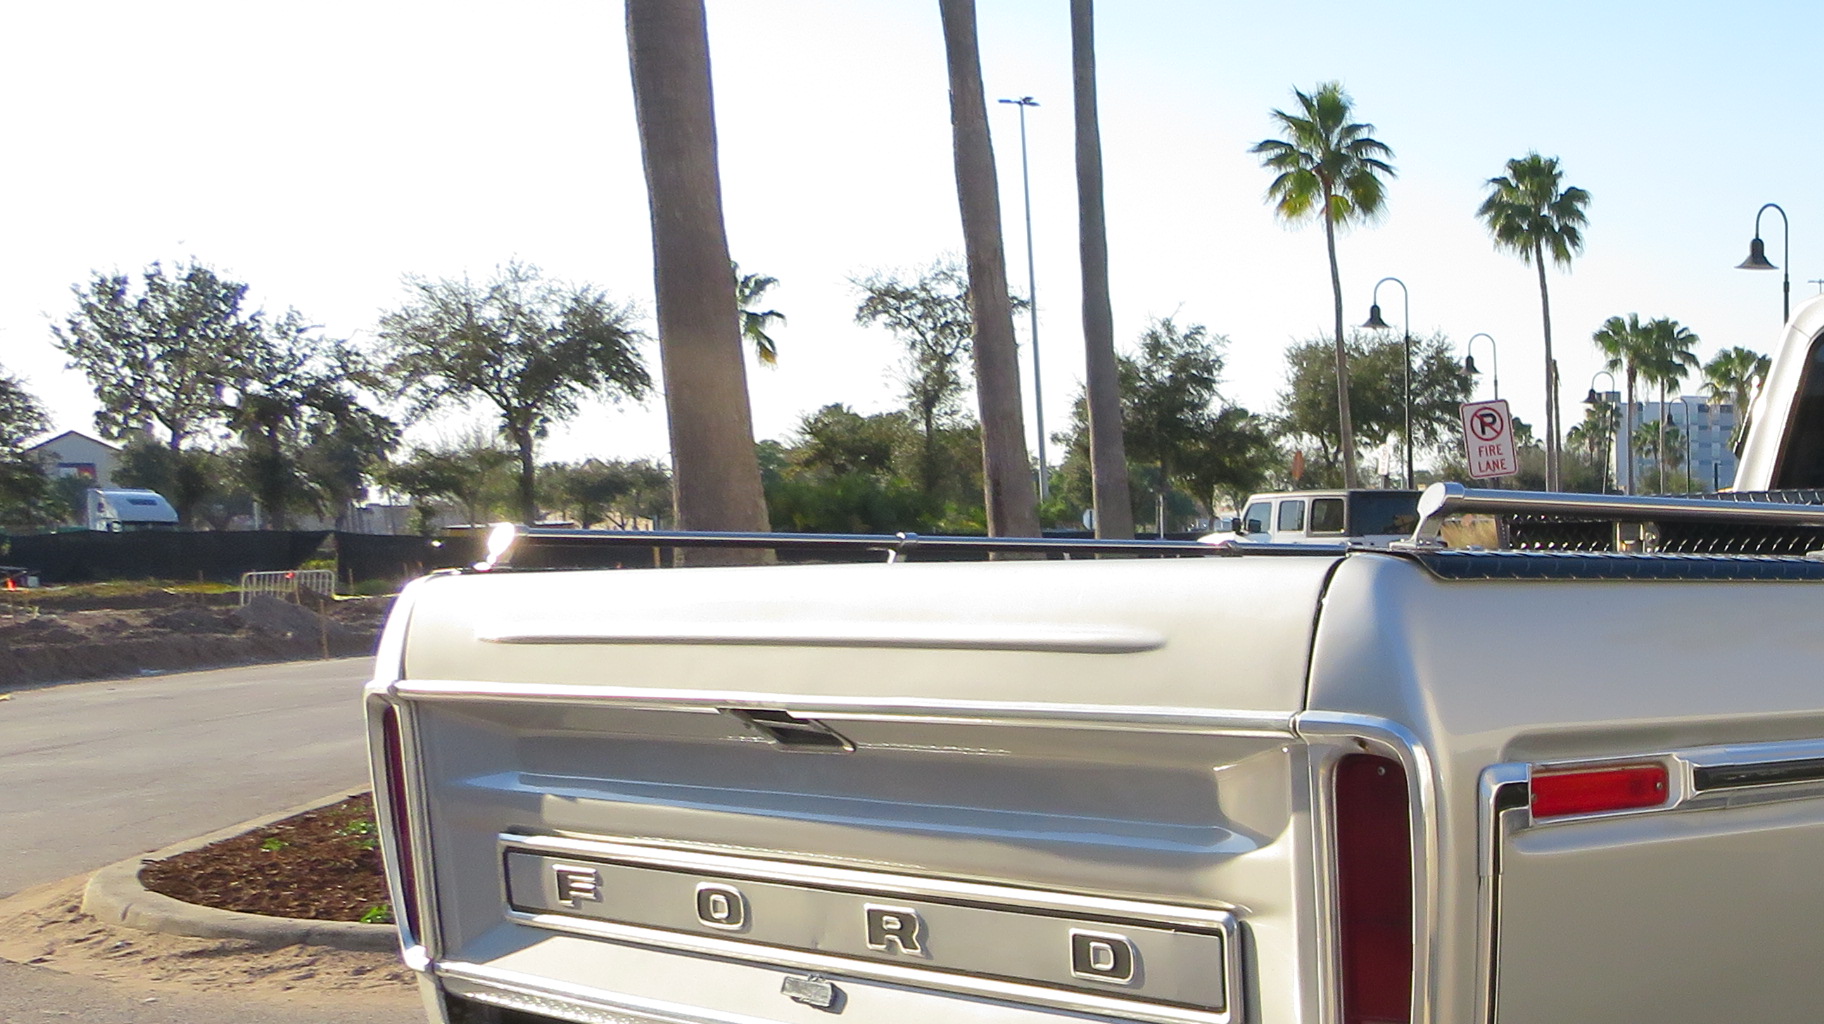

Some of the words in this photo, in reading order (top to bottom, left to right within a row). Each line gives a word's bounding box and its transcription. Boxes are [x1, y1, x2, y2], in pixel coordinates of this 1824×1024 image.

[1478, 443, 1503, 457] FIRE
[1478, 458, 1507, 473] LANE
[553, 864, 1138, 985] FORD
